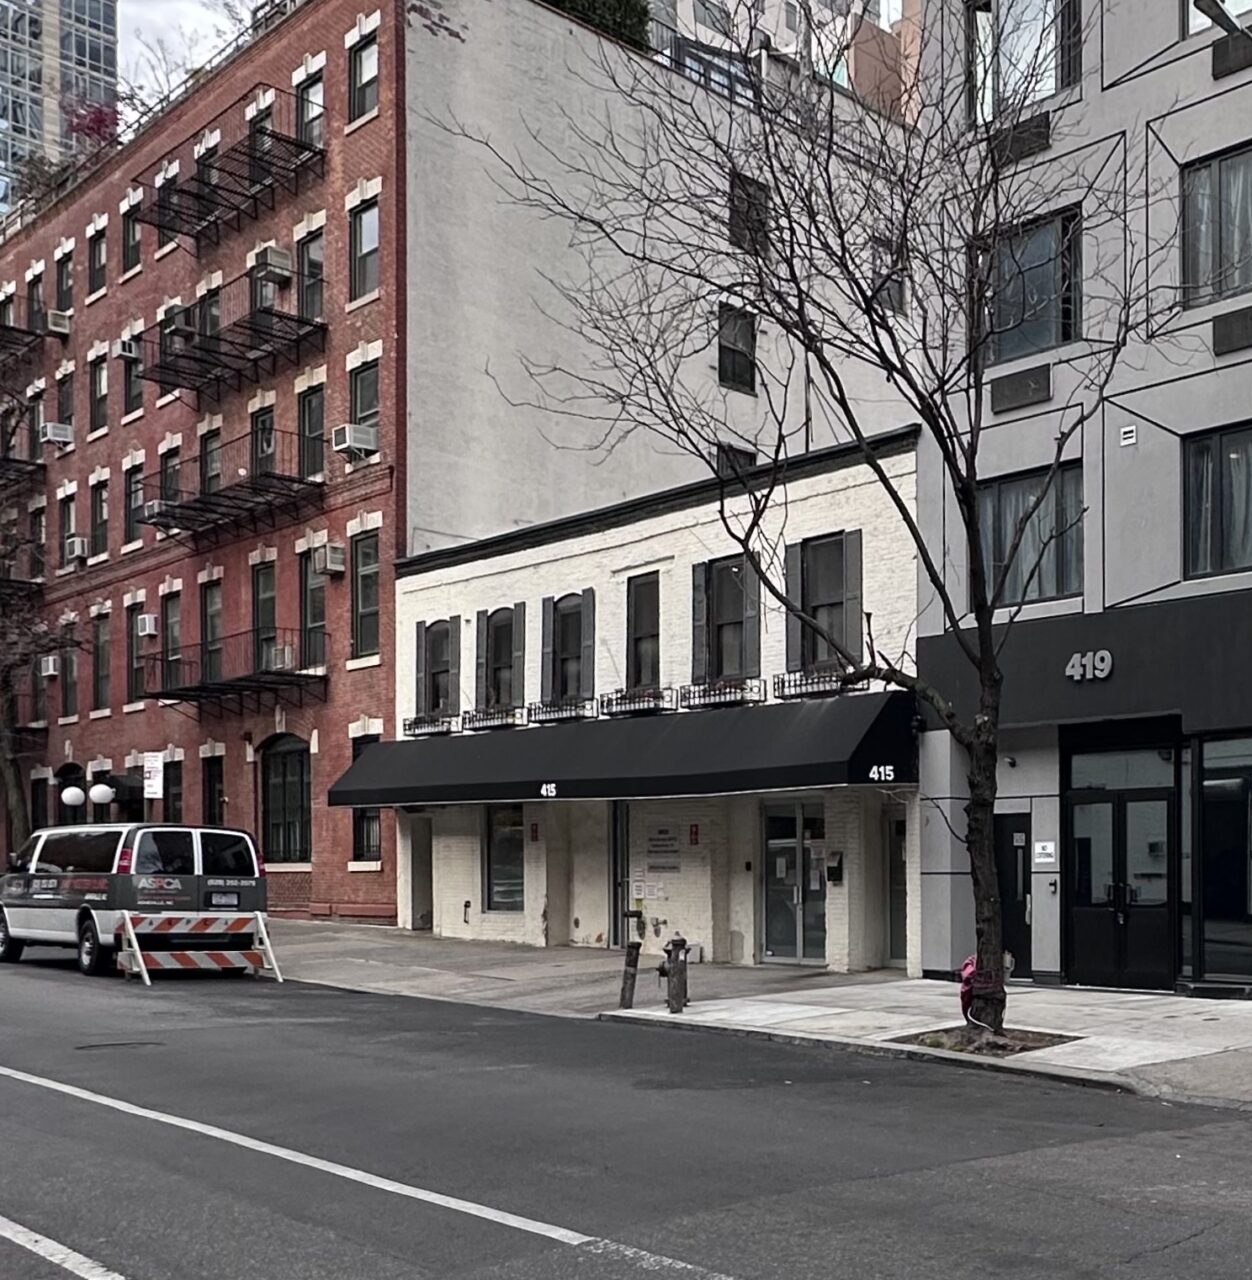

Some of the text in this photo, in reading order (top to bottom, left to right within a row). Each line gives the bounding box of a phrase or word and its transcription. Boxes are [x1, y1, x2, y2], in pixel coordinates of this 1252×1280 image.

[1065, 649, 1113, 680] 419
[869, 765, 894, 780] 415
[540, 783, 557, 797] 415
[138, 877, 182, 889] ASPCA
